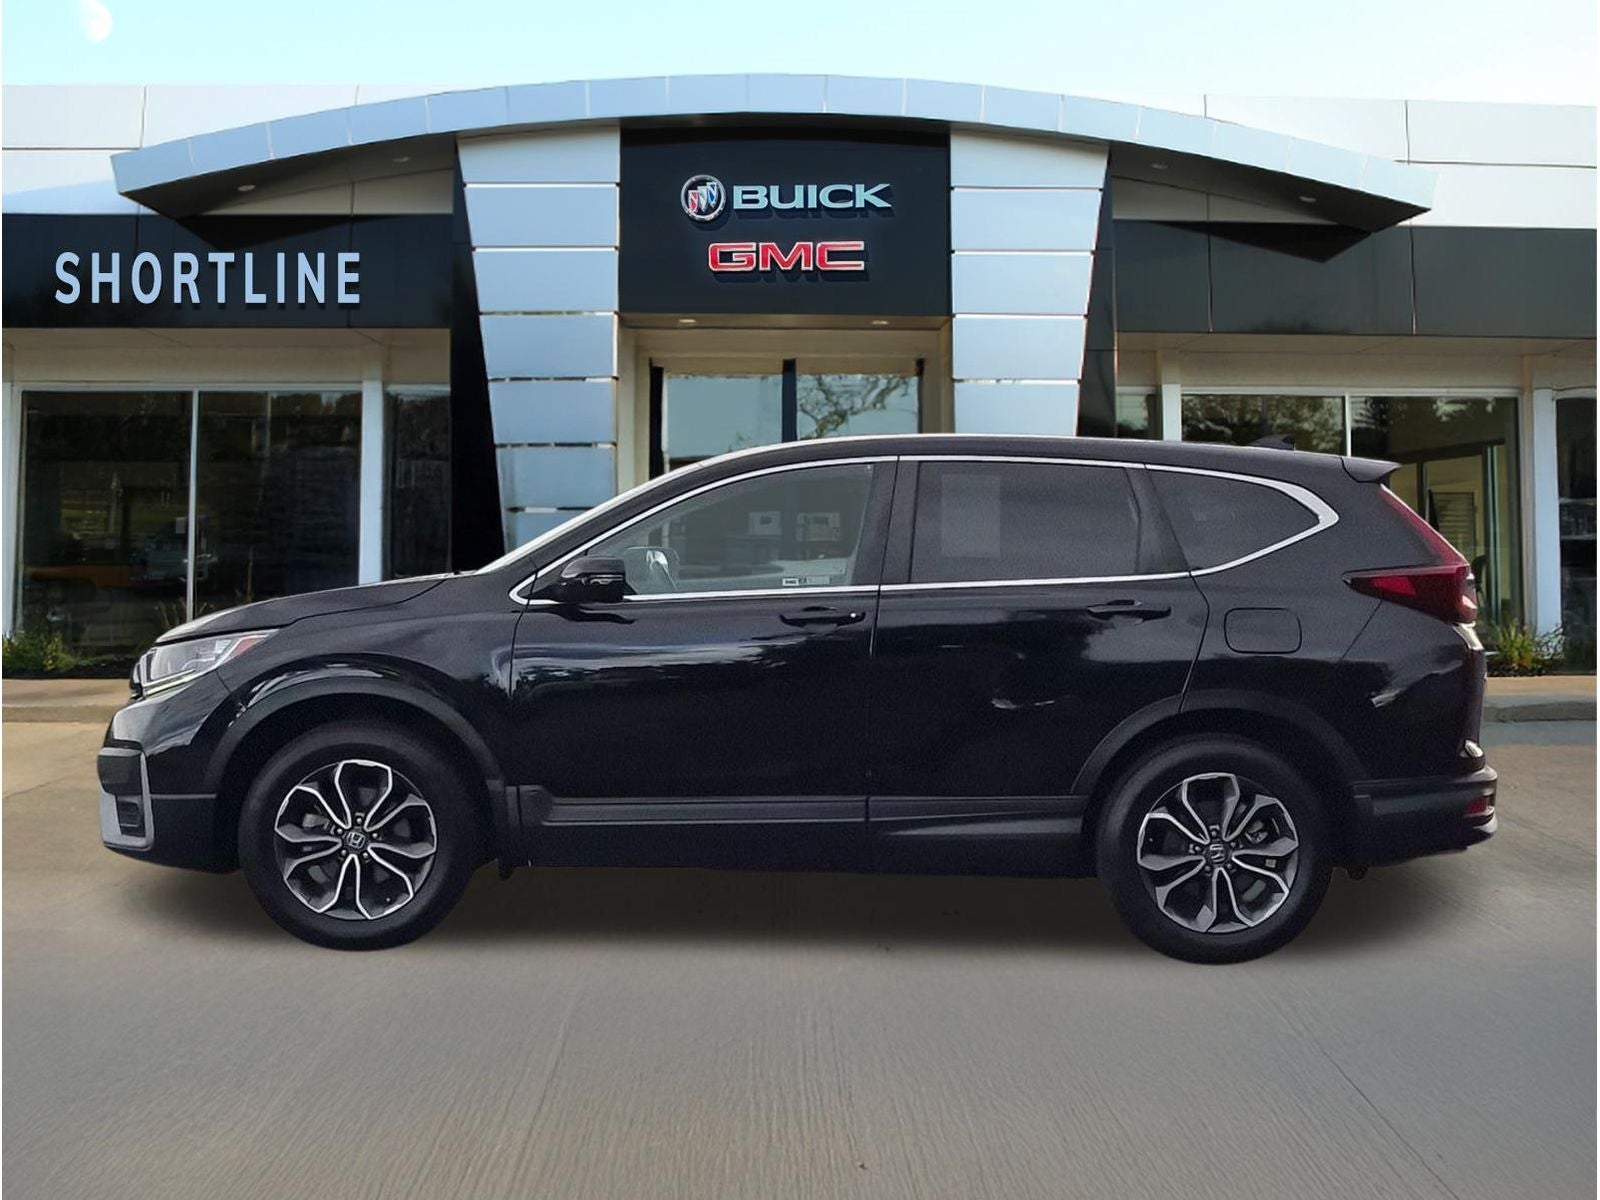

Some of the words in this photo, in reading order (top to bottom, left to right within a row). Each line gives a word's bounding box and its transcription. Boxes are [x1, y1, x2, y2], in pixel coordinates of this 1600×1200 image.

[733, 183, 892, 210] BUICK
[708, 241, 865, 271] GMC
[55, 251, 361, 304] SHORTLINE
